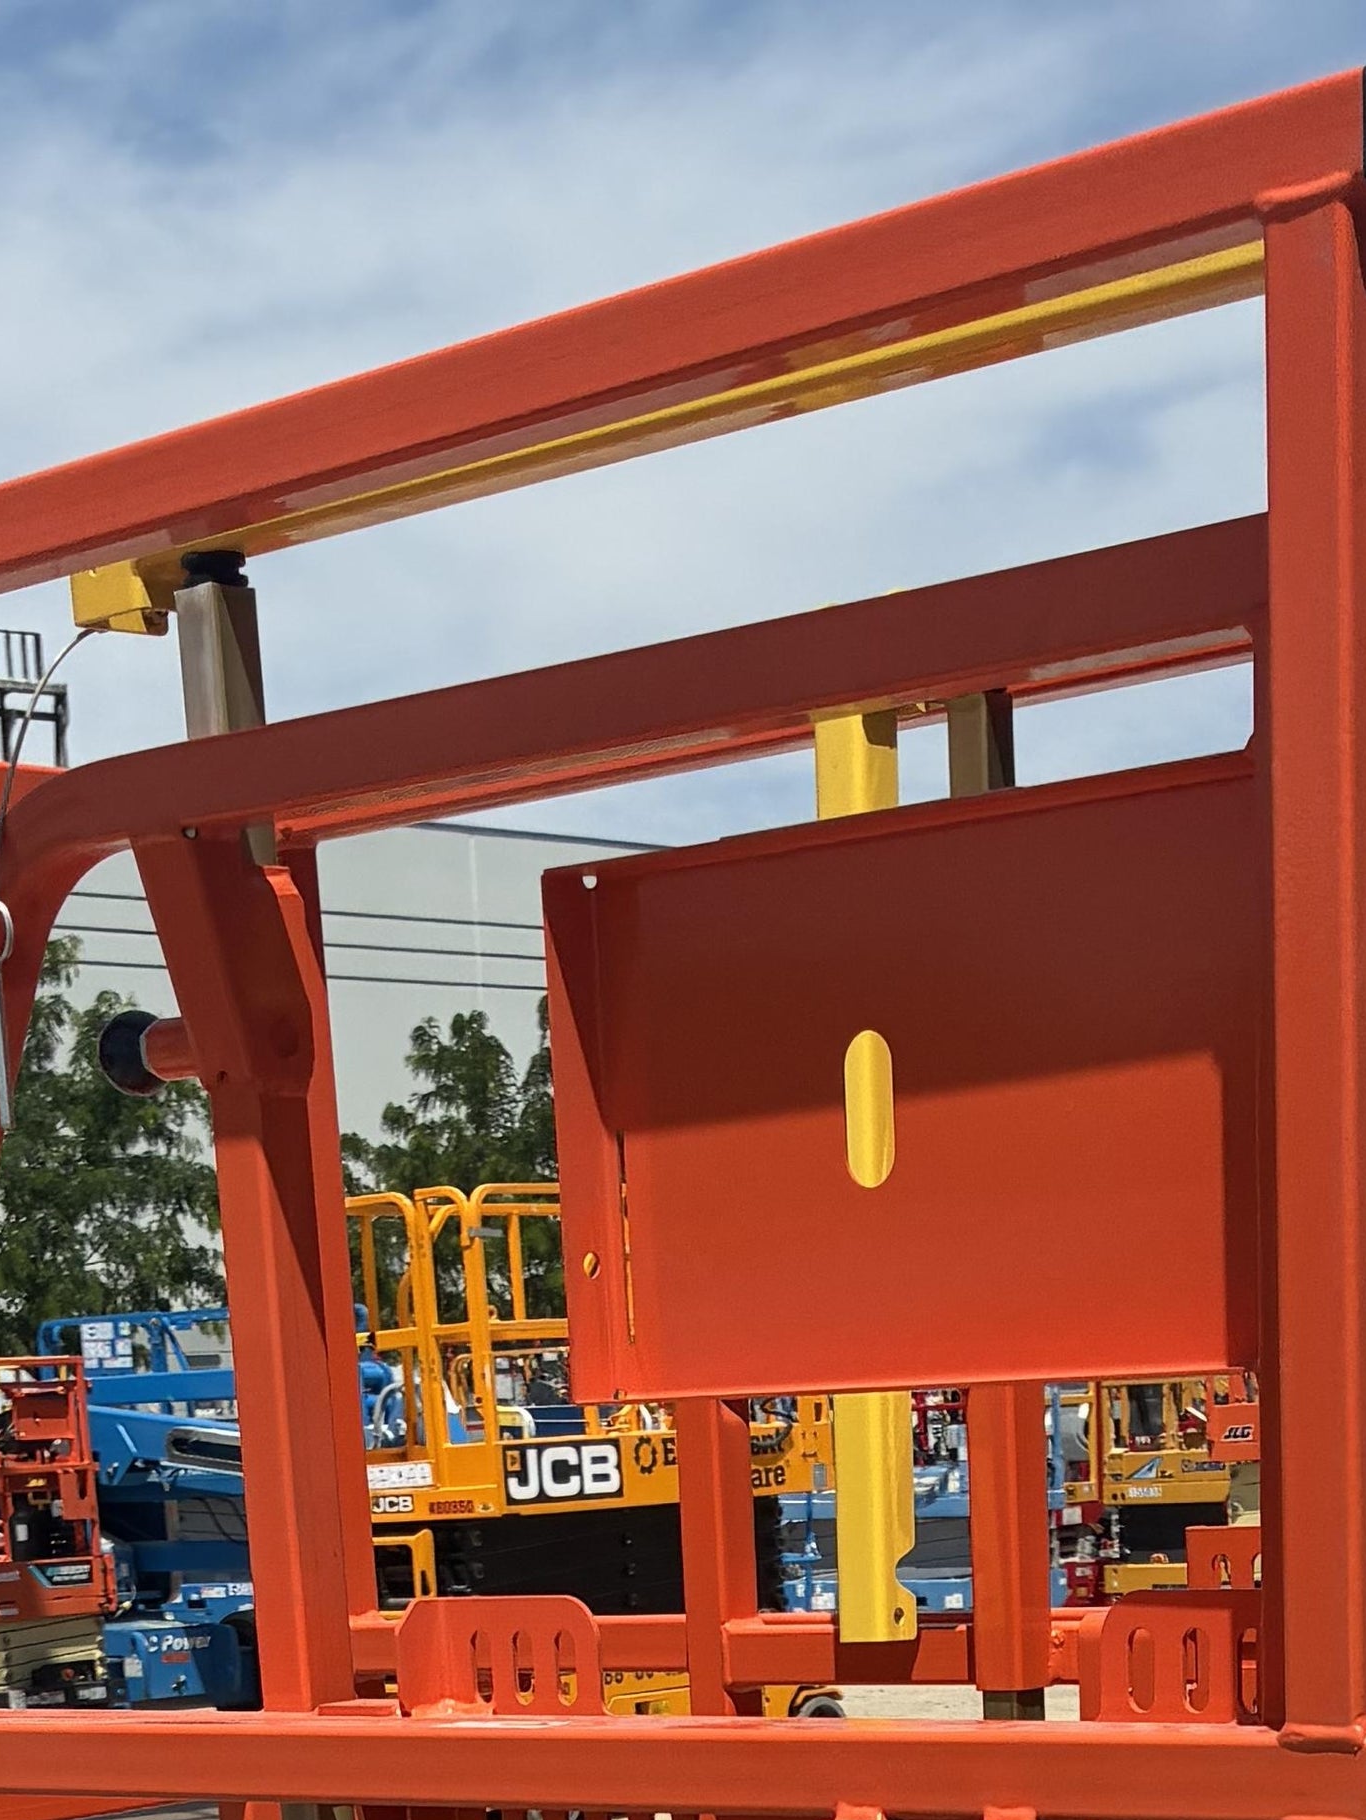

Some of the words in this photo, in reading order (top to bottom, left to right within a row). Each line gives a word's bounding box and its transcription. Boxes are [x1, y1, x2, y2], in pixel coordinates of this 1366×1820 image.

[507, 1445, 621, 1500] JCB
[372, 1496, 414, 1513] JCB
[161, 1635, 211, 1652] Power
